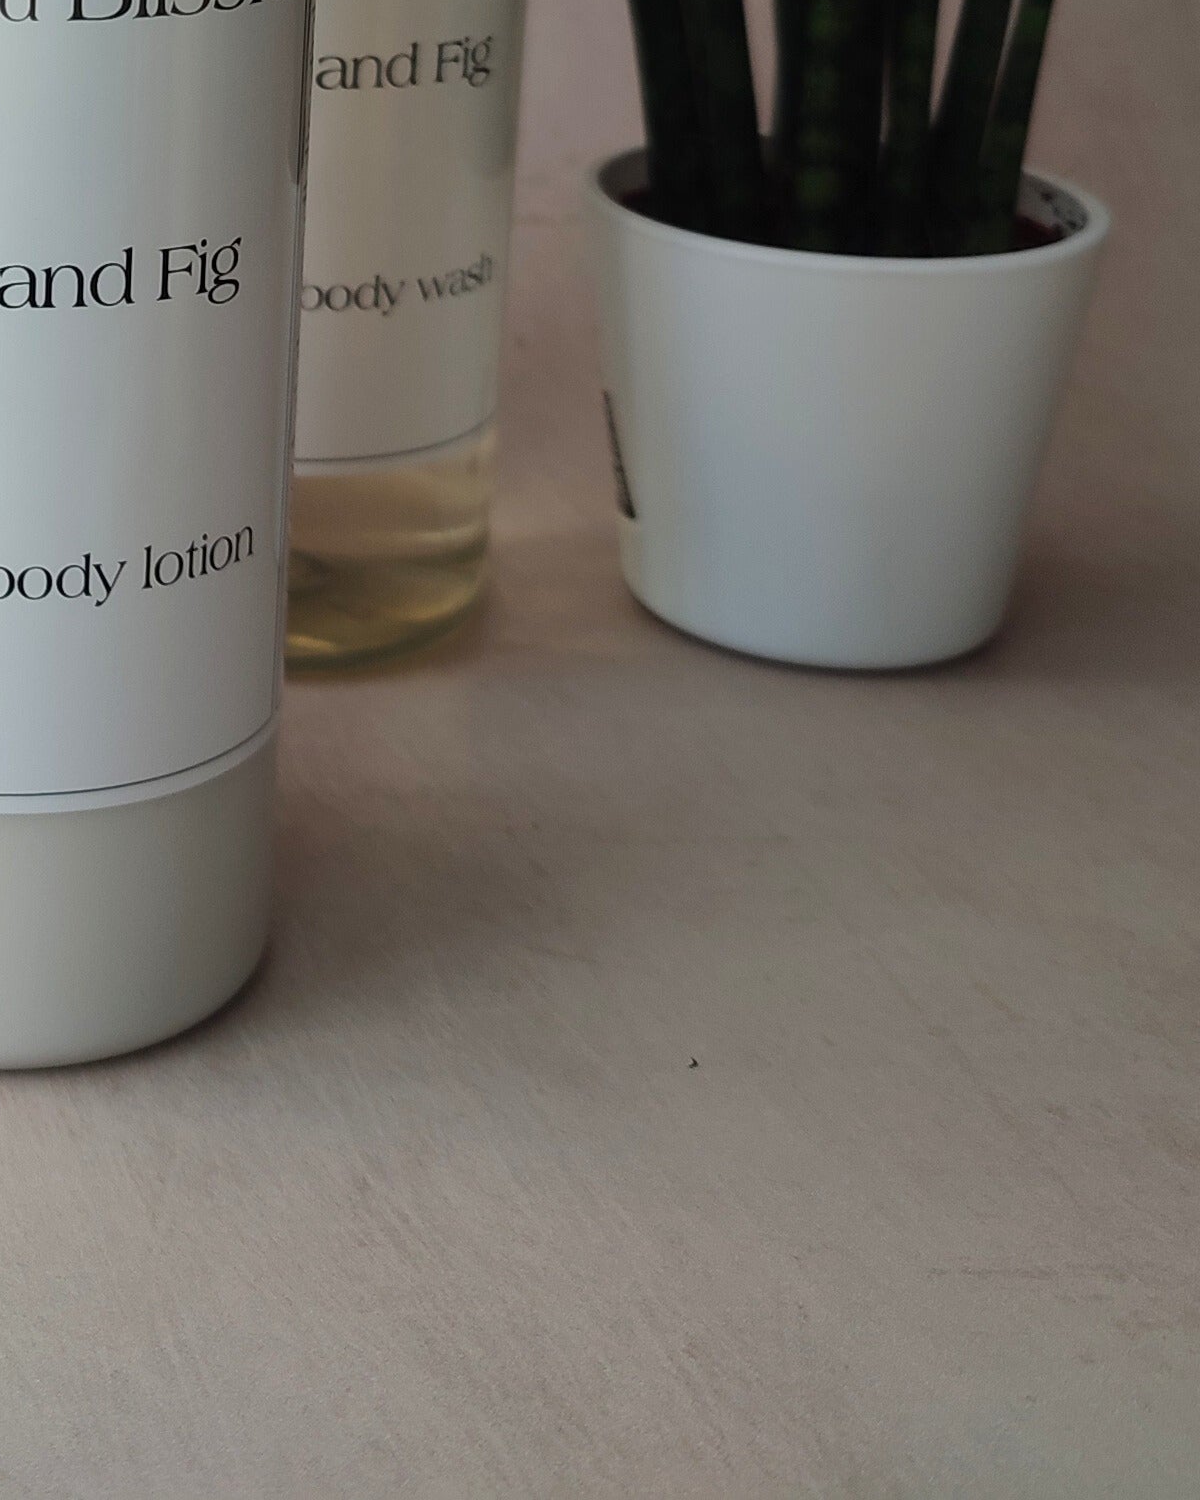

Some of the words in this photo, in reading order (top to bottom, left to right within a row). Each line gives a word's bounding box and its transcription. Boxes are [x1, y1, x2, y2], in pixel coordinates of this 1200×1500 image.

[315, 41, 421, 90] and
[434, 36, 494, 88] Fig
[155, 236, 242, 305] Fig
[142, 526, 254, 590] lotion
